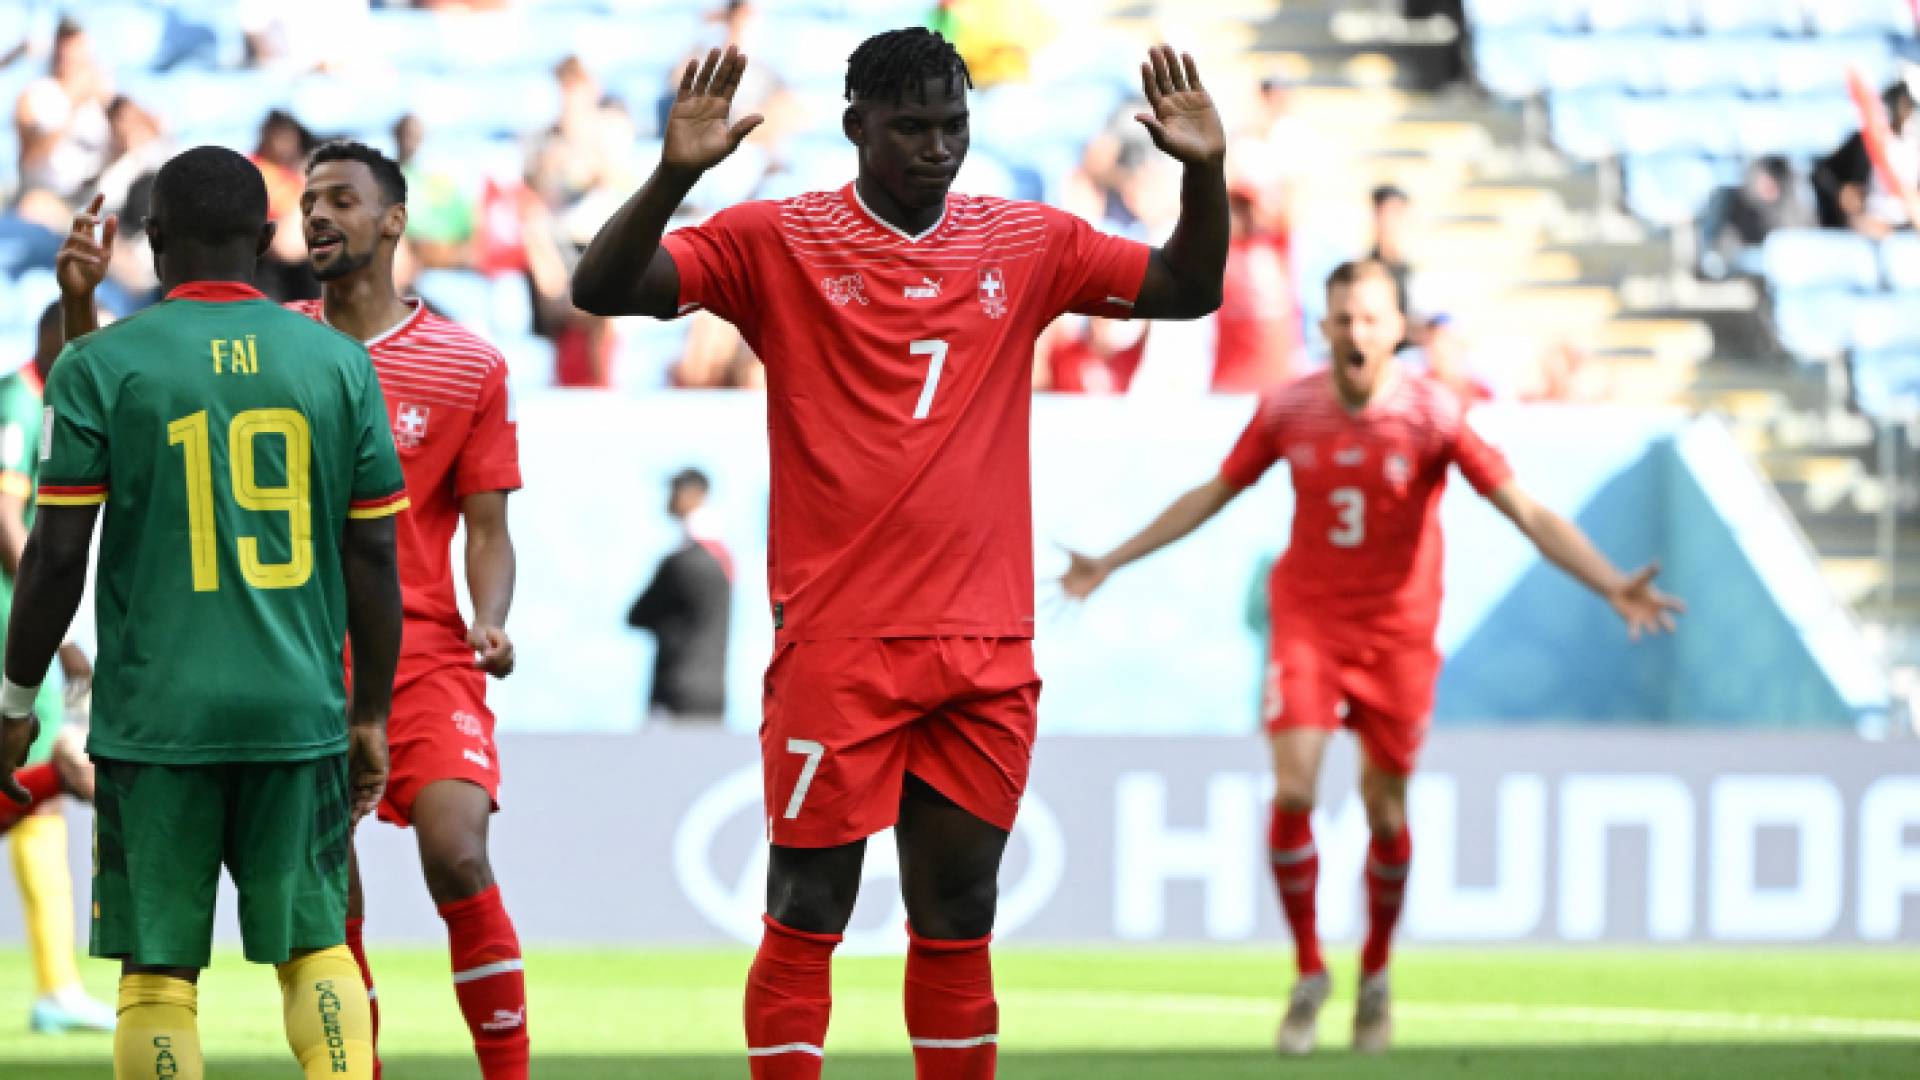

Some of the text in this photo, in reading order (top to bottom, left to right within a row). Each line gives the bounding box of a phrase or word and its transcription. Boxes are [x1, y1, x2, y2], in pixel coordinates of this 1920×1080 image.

[210, 334, 257, 374] FAÏ
[909, 340, 949, 419] 7
[167, 408, 312, 591] 19
[1329, 488, 1364, 547] 3
[784, 738, 825, 819] 7
